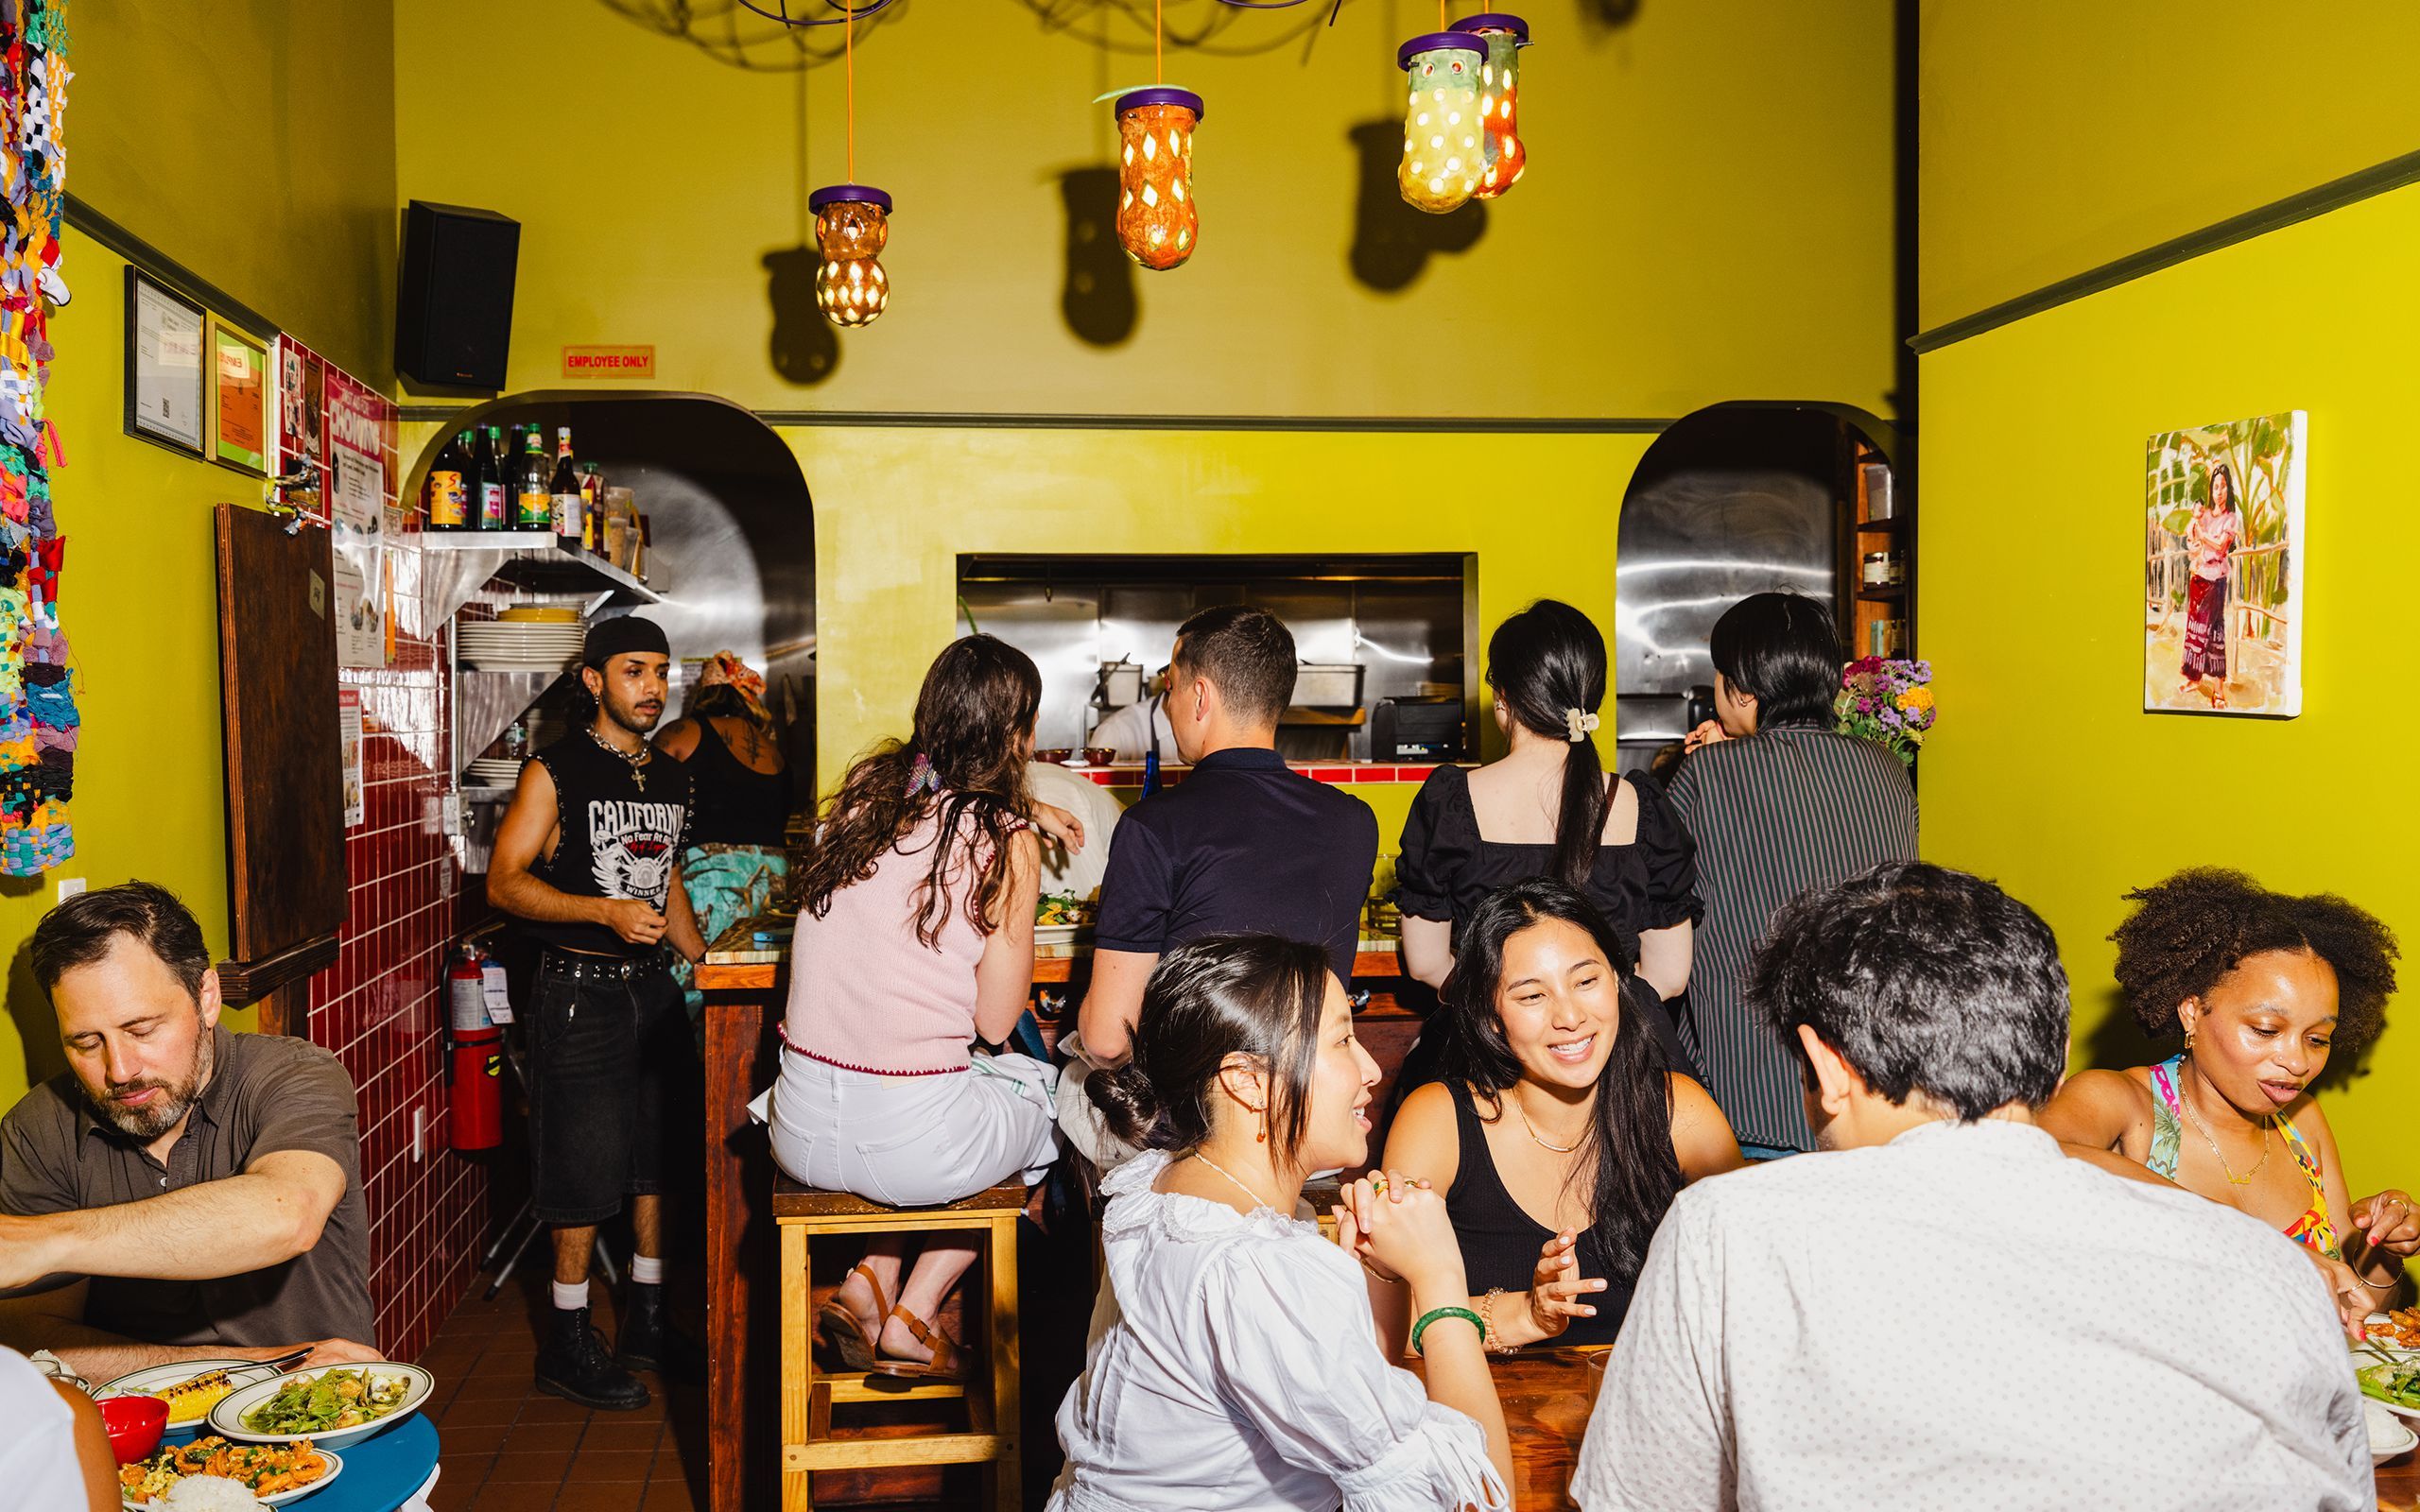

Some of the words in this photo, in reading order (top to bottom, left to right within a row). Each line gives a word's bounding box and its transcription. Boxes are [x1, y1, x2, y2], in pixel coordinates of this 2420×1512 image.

[568, 355, 620, 368] EMPLOYEE
[622, 355, 648, 368] ONLY
[620, 833, 633, 846] No
[634, 832, 652, 842] Fear
[626, 885, 662, 897] WINNER
